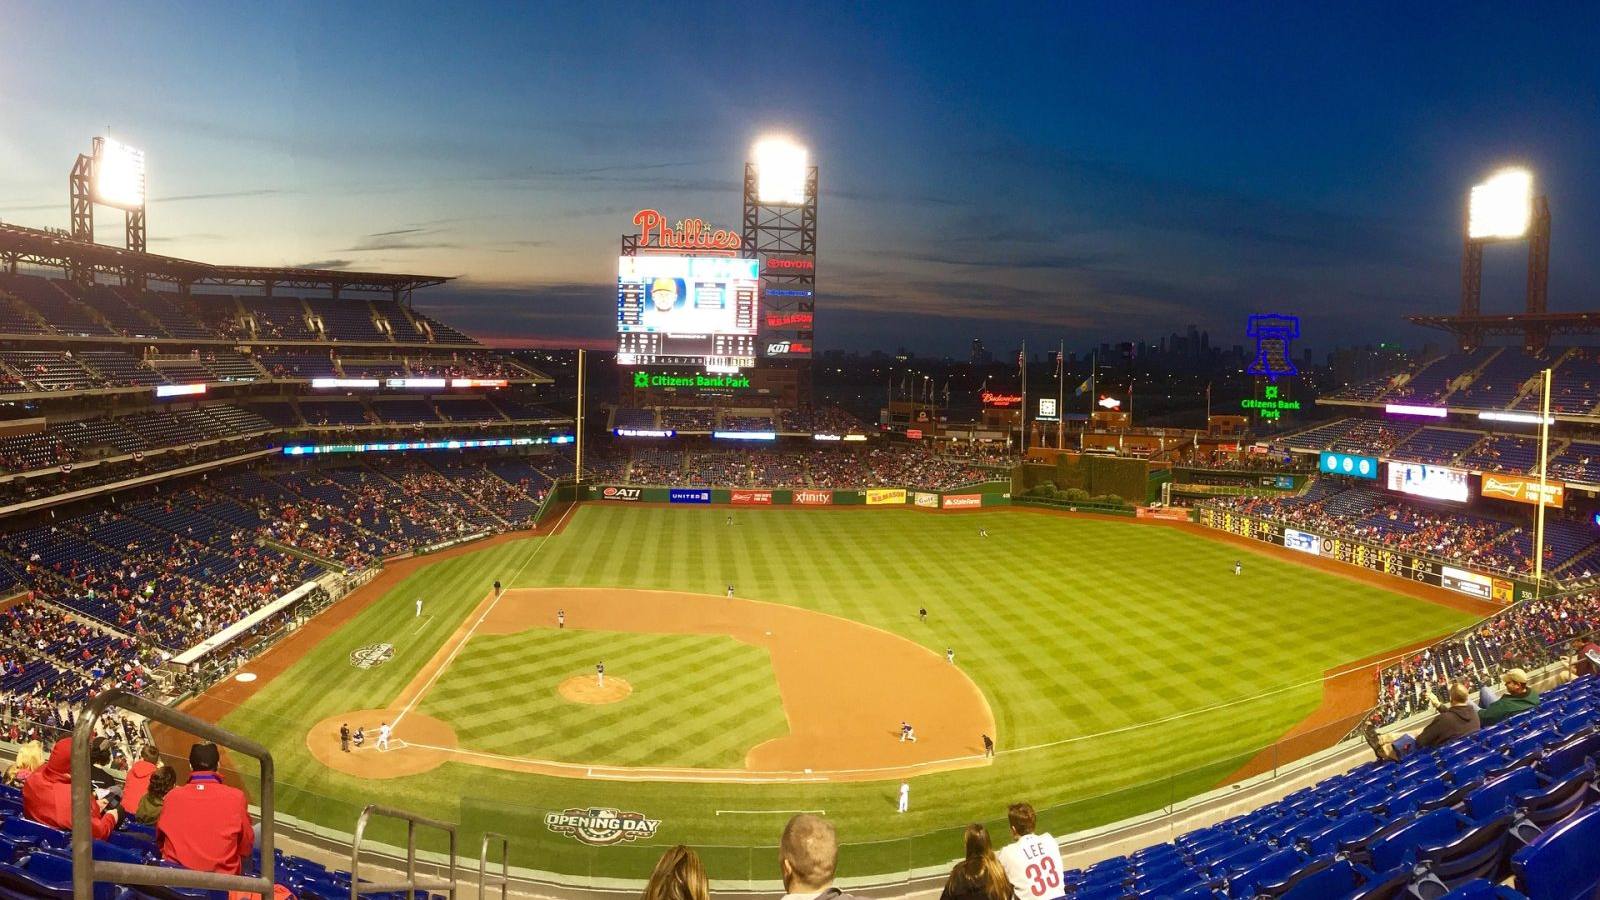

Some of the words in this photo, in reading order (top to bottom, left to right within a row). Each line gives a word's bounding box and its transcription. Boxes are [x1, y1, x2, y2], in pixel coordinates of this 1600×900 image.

[633, 209, 742, 249] Phillies
[780, 260, 813, 270] TOYOTA
[652, 375, 694, 387] Citizens
[697, 376, 726, 387] Bank
[726, 377, 750, 388] Park
[1241, 400, 1277, 408] Citizens
[1278, 401, 1300, 409] Bank
[1261, 409, 1281, 418] Park
[616, 488, 641, 497] ATI
[796, 492, 830, 504] xfinity
[1522, 591, 1532, 599] 330
[546, 815, 620, 830] OPENING
[622, 819, 659, 831] DAY
[1023, 843, 1045, 860] LEE
[1025, 856, 1060, 897] 33
